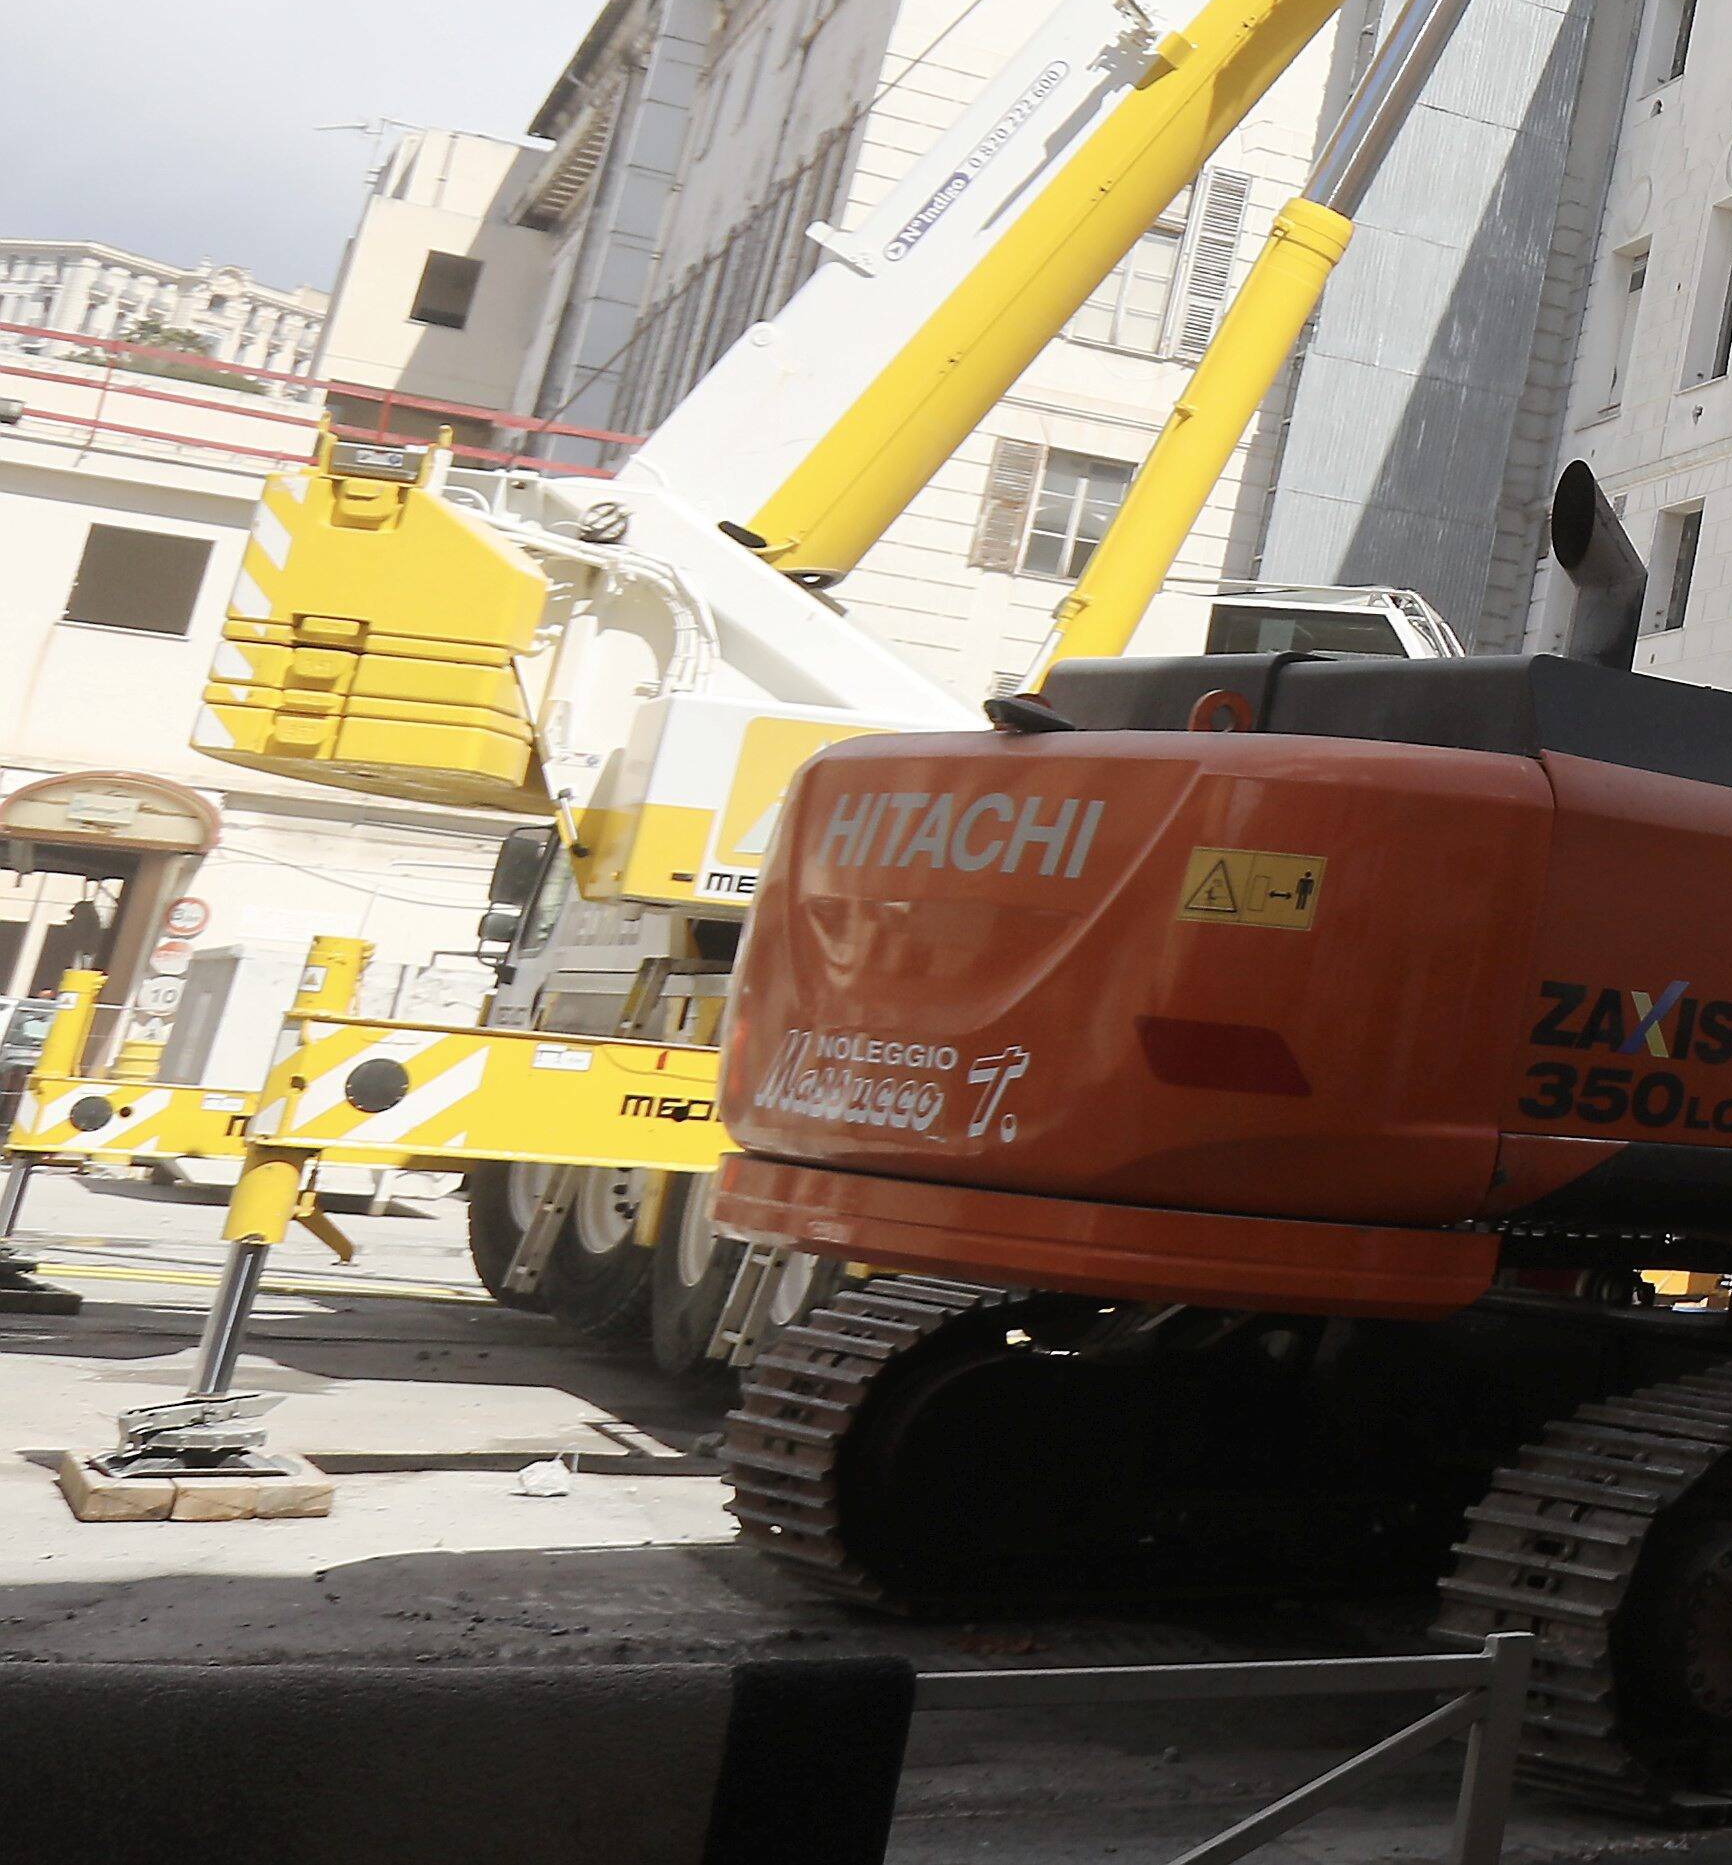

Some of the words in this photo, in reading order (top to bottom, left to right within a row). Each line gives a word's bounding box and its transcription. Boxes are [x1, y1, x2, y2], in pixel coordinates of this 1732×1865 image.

[969, 157, 981, 168] 0
[979, 128, 1008, 157] 820
[1007, 99, 1031, 129] 222
[1033, 71, 1059, 98] 600
[815, 792, 1105, 878] HITACHI
[754, 1028, 945, 1131] Massucco
[816, 1035, 958, 1070] NOLEGGIO
